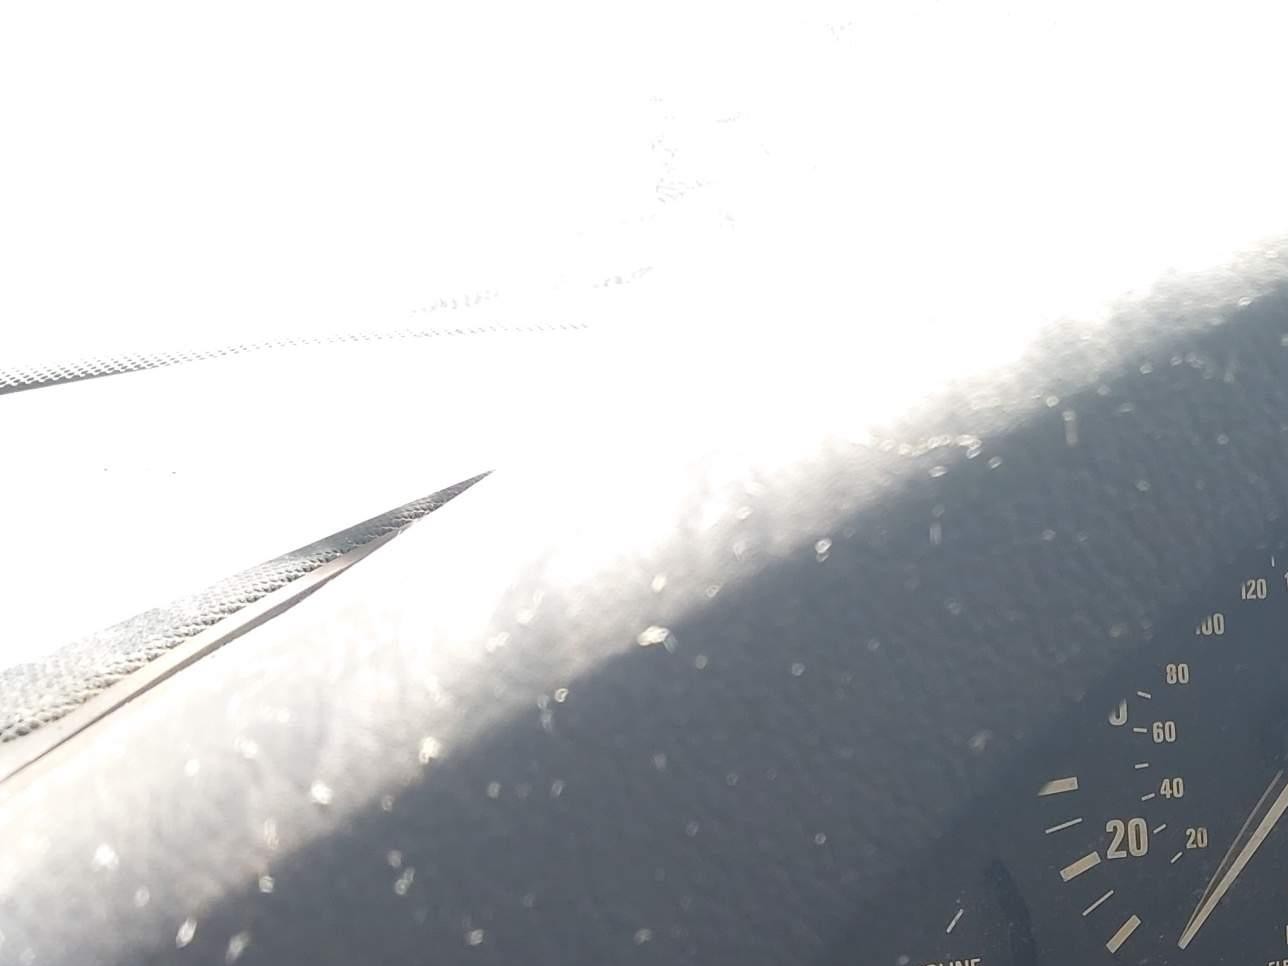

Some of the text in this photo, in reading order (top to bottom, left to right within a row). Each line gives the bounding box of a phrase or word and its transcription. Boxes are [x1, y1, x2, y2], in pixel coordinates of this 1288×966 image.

[1166, 663, 1189, 685] 80
[1152, 721, 1176, 743] 60
[1160, 777, 1184, 799] 40
[1105, 817, 1148, 859] 20
[1185, 827, 1208, 849] 20
